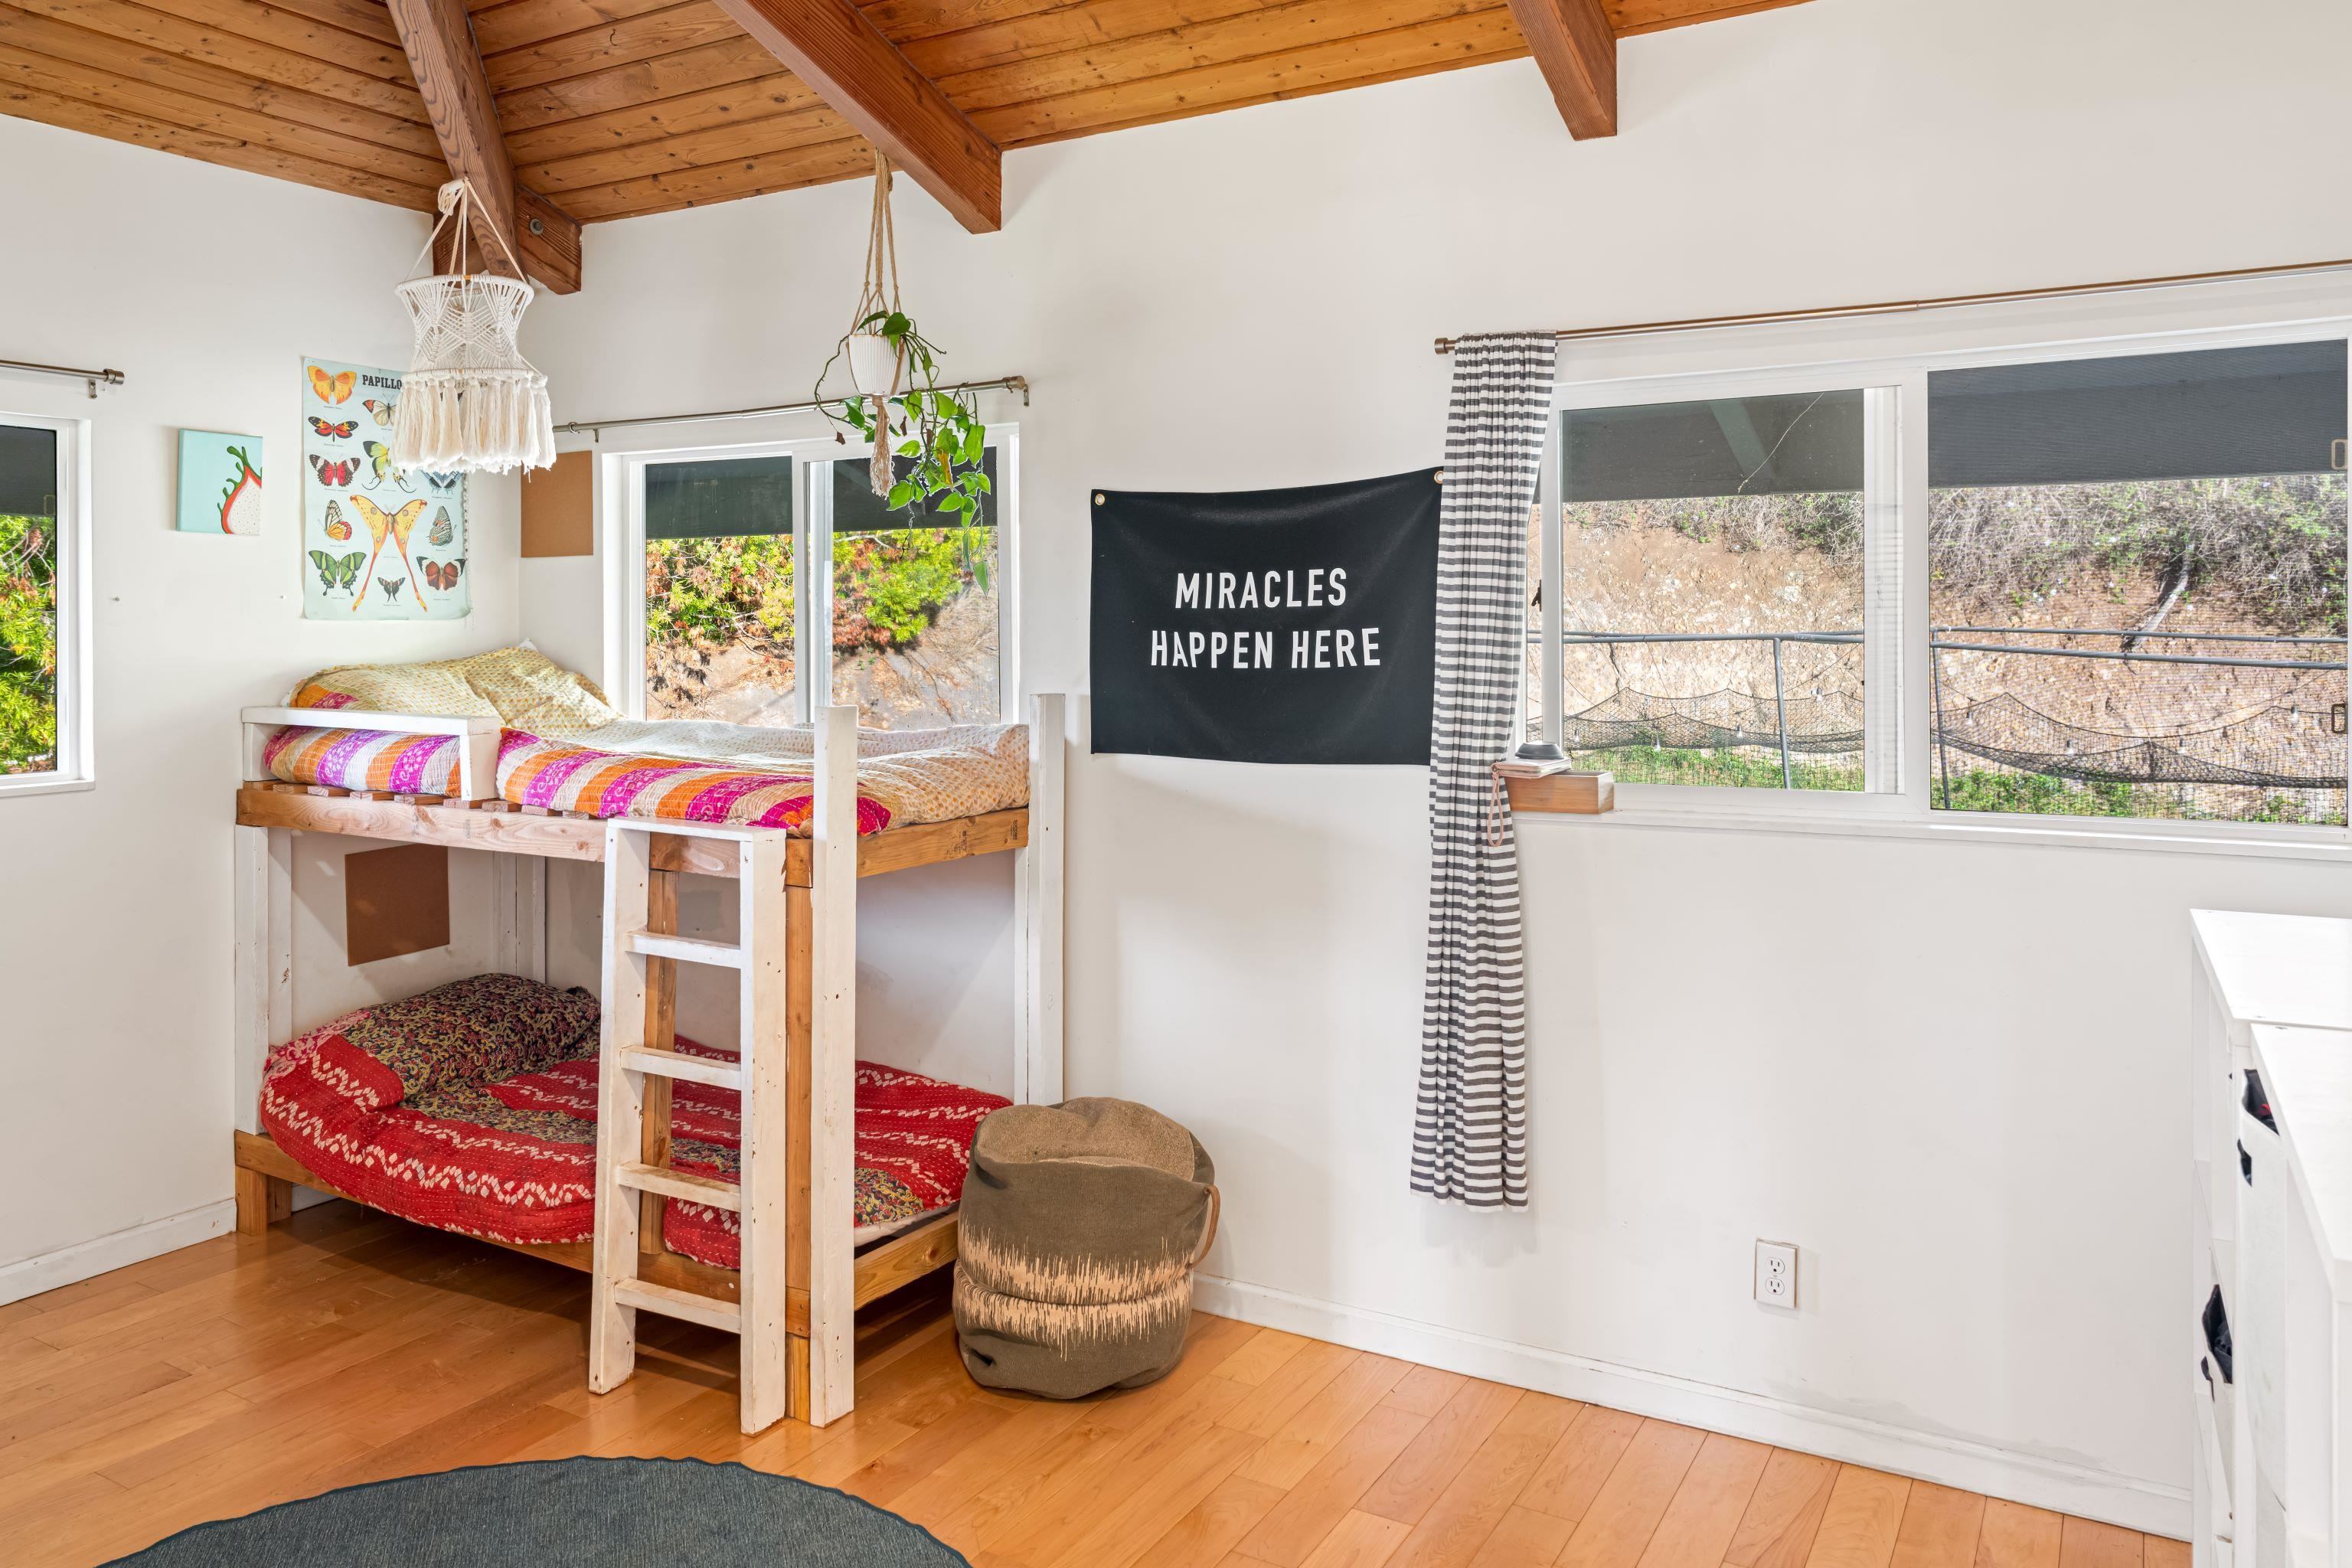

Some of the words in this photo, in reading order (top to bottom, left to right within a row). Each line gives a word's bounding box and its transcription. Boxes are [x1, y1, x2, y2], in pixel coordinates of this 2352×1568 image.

[1175, 568, 1347, 609] MIRACLES
[1151, 630, 1273, 669] HAPPEN
[1291, 627, 1380, 668] HERE
